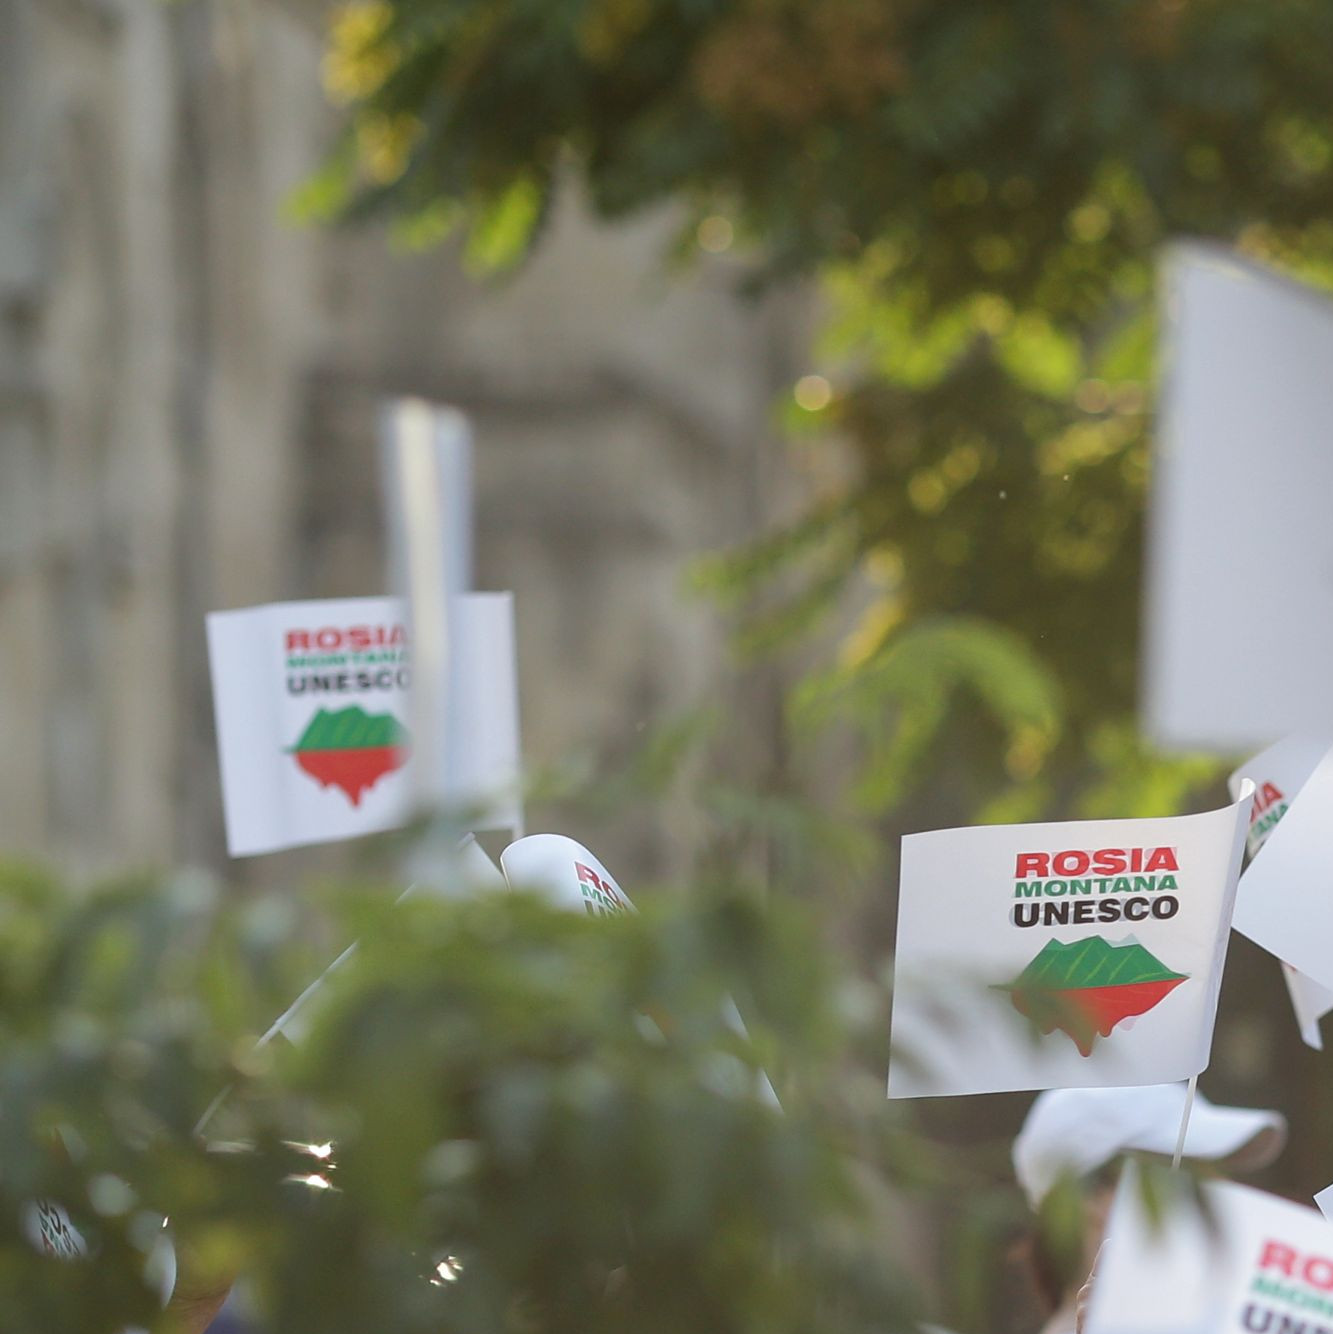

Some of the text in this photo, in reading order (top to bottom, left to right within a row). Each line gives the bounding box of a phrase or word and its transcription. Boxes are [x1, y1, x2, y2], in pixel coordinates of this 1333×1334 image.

[1015, 847, 1179, 878] ROSIA
[1015, 875, 1178, 898] MONTANA
[1014, 896, 1179, 927] UNESCO
